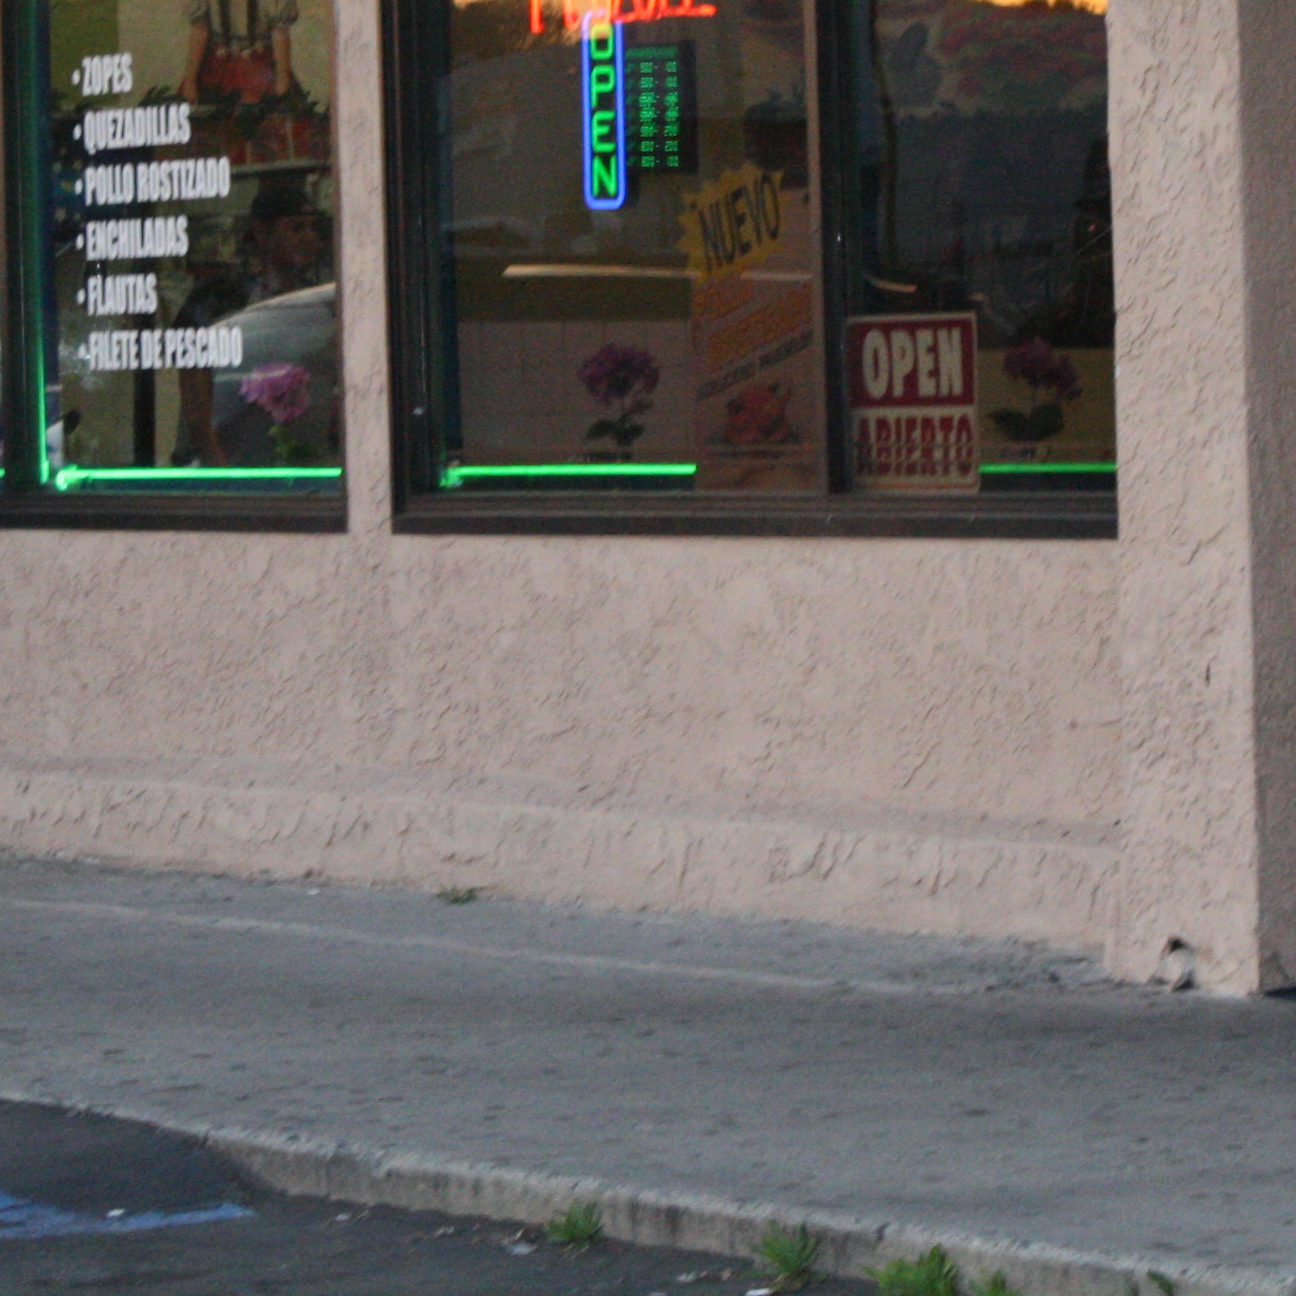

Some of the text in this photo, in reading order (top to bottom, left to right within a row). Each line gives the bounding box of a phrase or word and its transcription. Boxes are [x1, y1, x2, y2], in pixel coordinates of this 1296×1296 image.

[82, 53, 133, 96] ZOPES
[83, 102, 192, 154] QUEZADILLAS
[590, 23, 619, 198] OPEN
[85, 156, 232, 206] POLLO ROSTIZADO
[86, 215, 190, 261] ENCHILADAS
[87, 273, 158, 316] FLAUTAS
[89, 326, 244, 371] FILETE DE PESCADO
[861, 326, 964, 402] OPEN
[856, 412, 974, 480] ABIERTO
